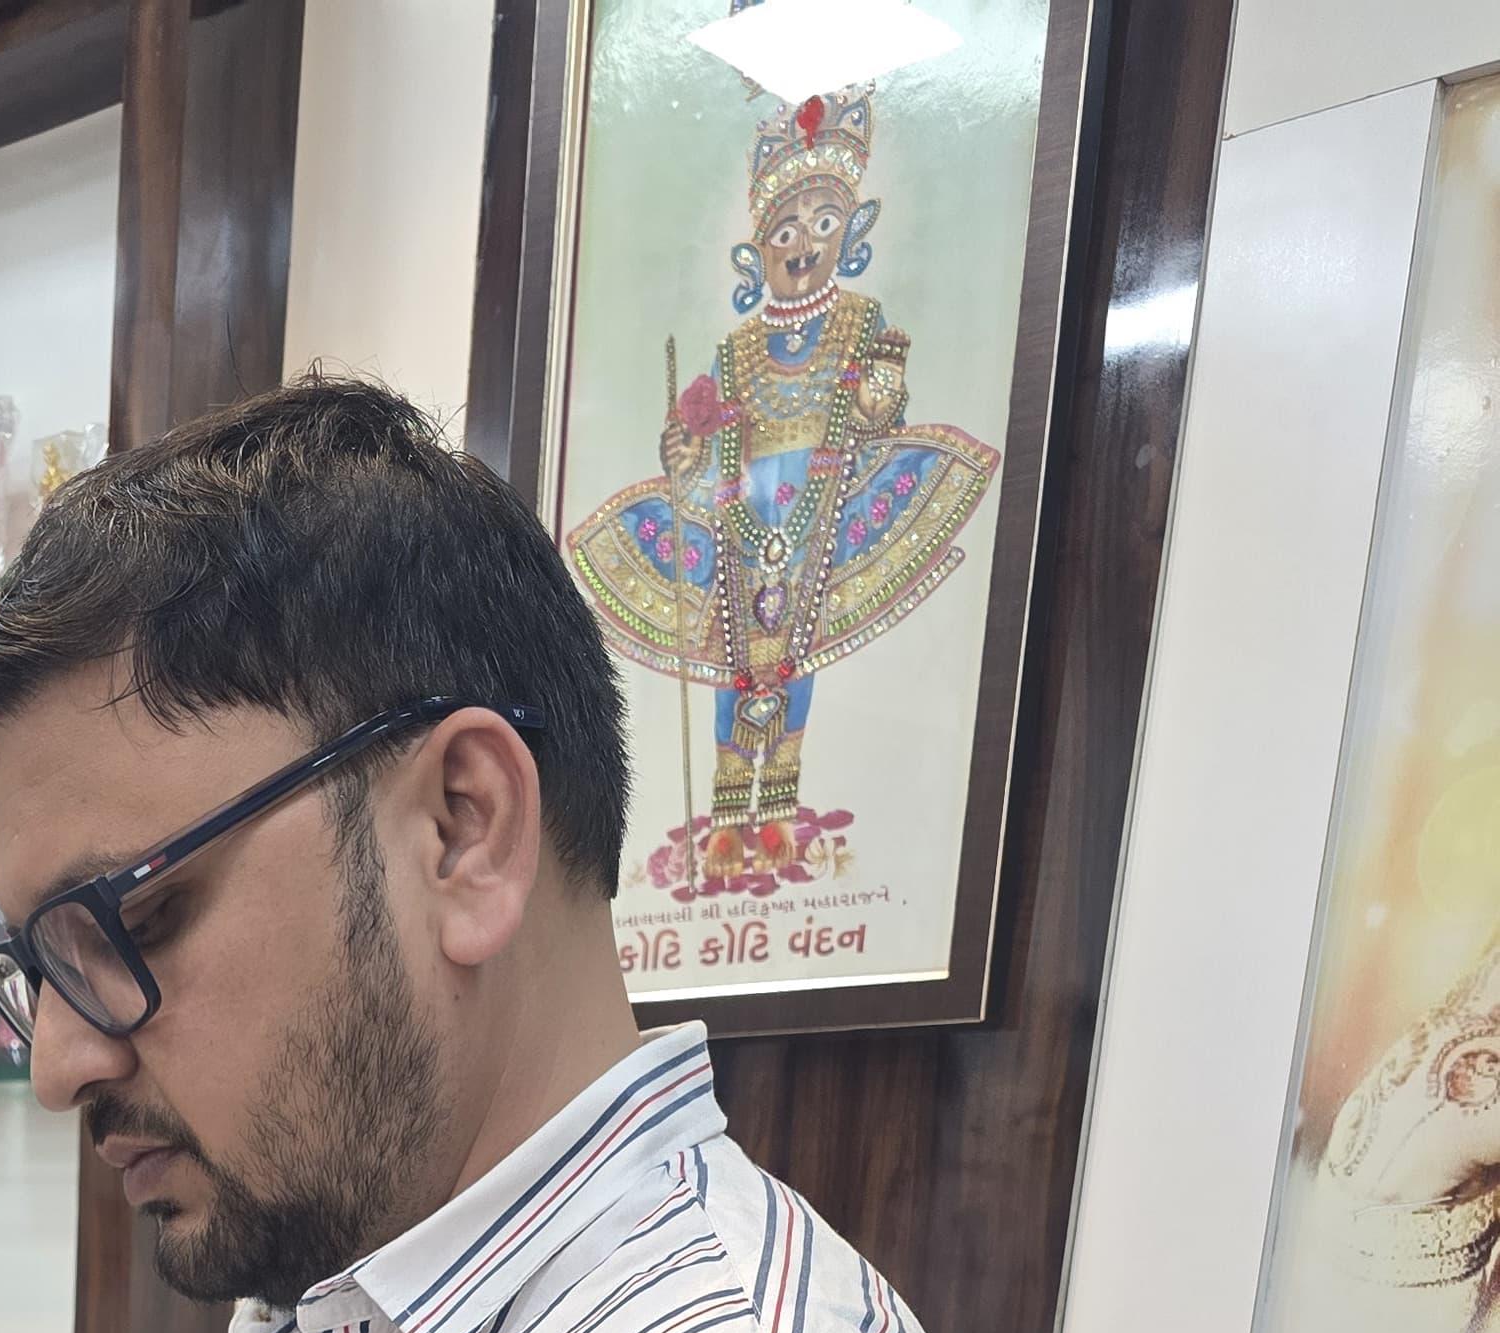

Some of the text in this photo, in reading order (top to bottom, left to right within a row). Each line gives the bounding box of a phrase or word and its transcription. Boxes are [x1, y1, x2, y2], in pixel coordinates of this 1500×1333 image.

[619, 915, 867, 973] કોટિ કોટિ વંદન
